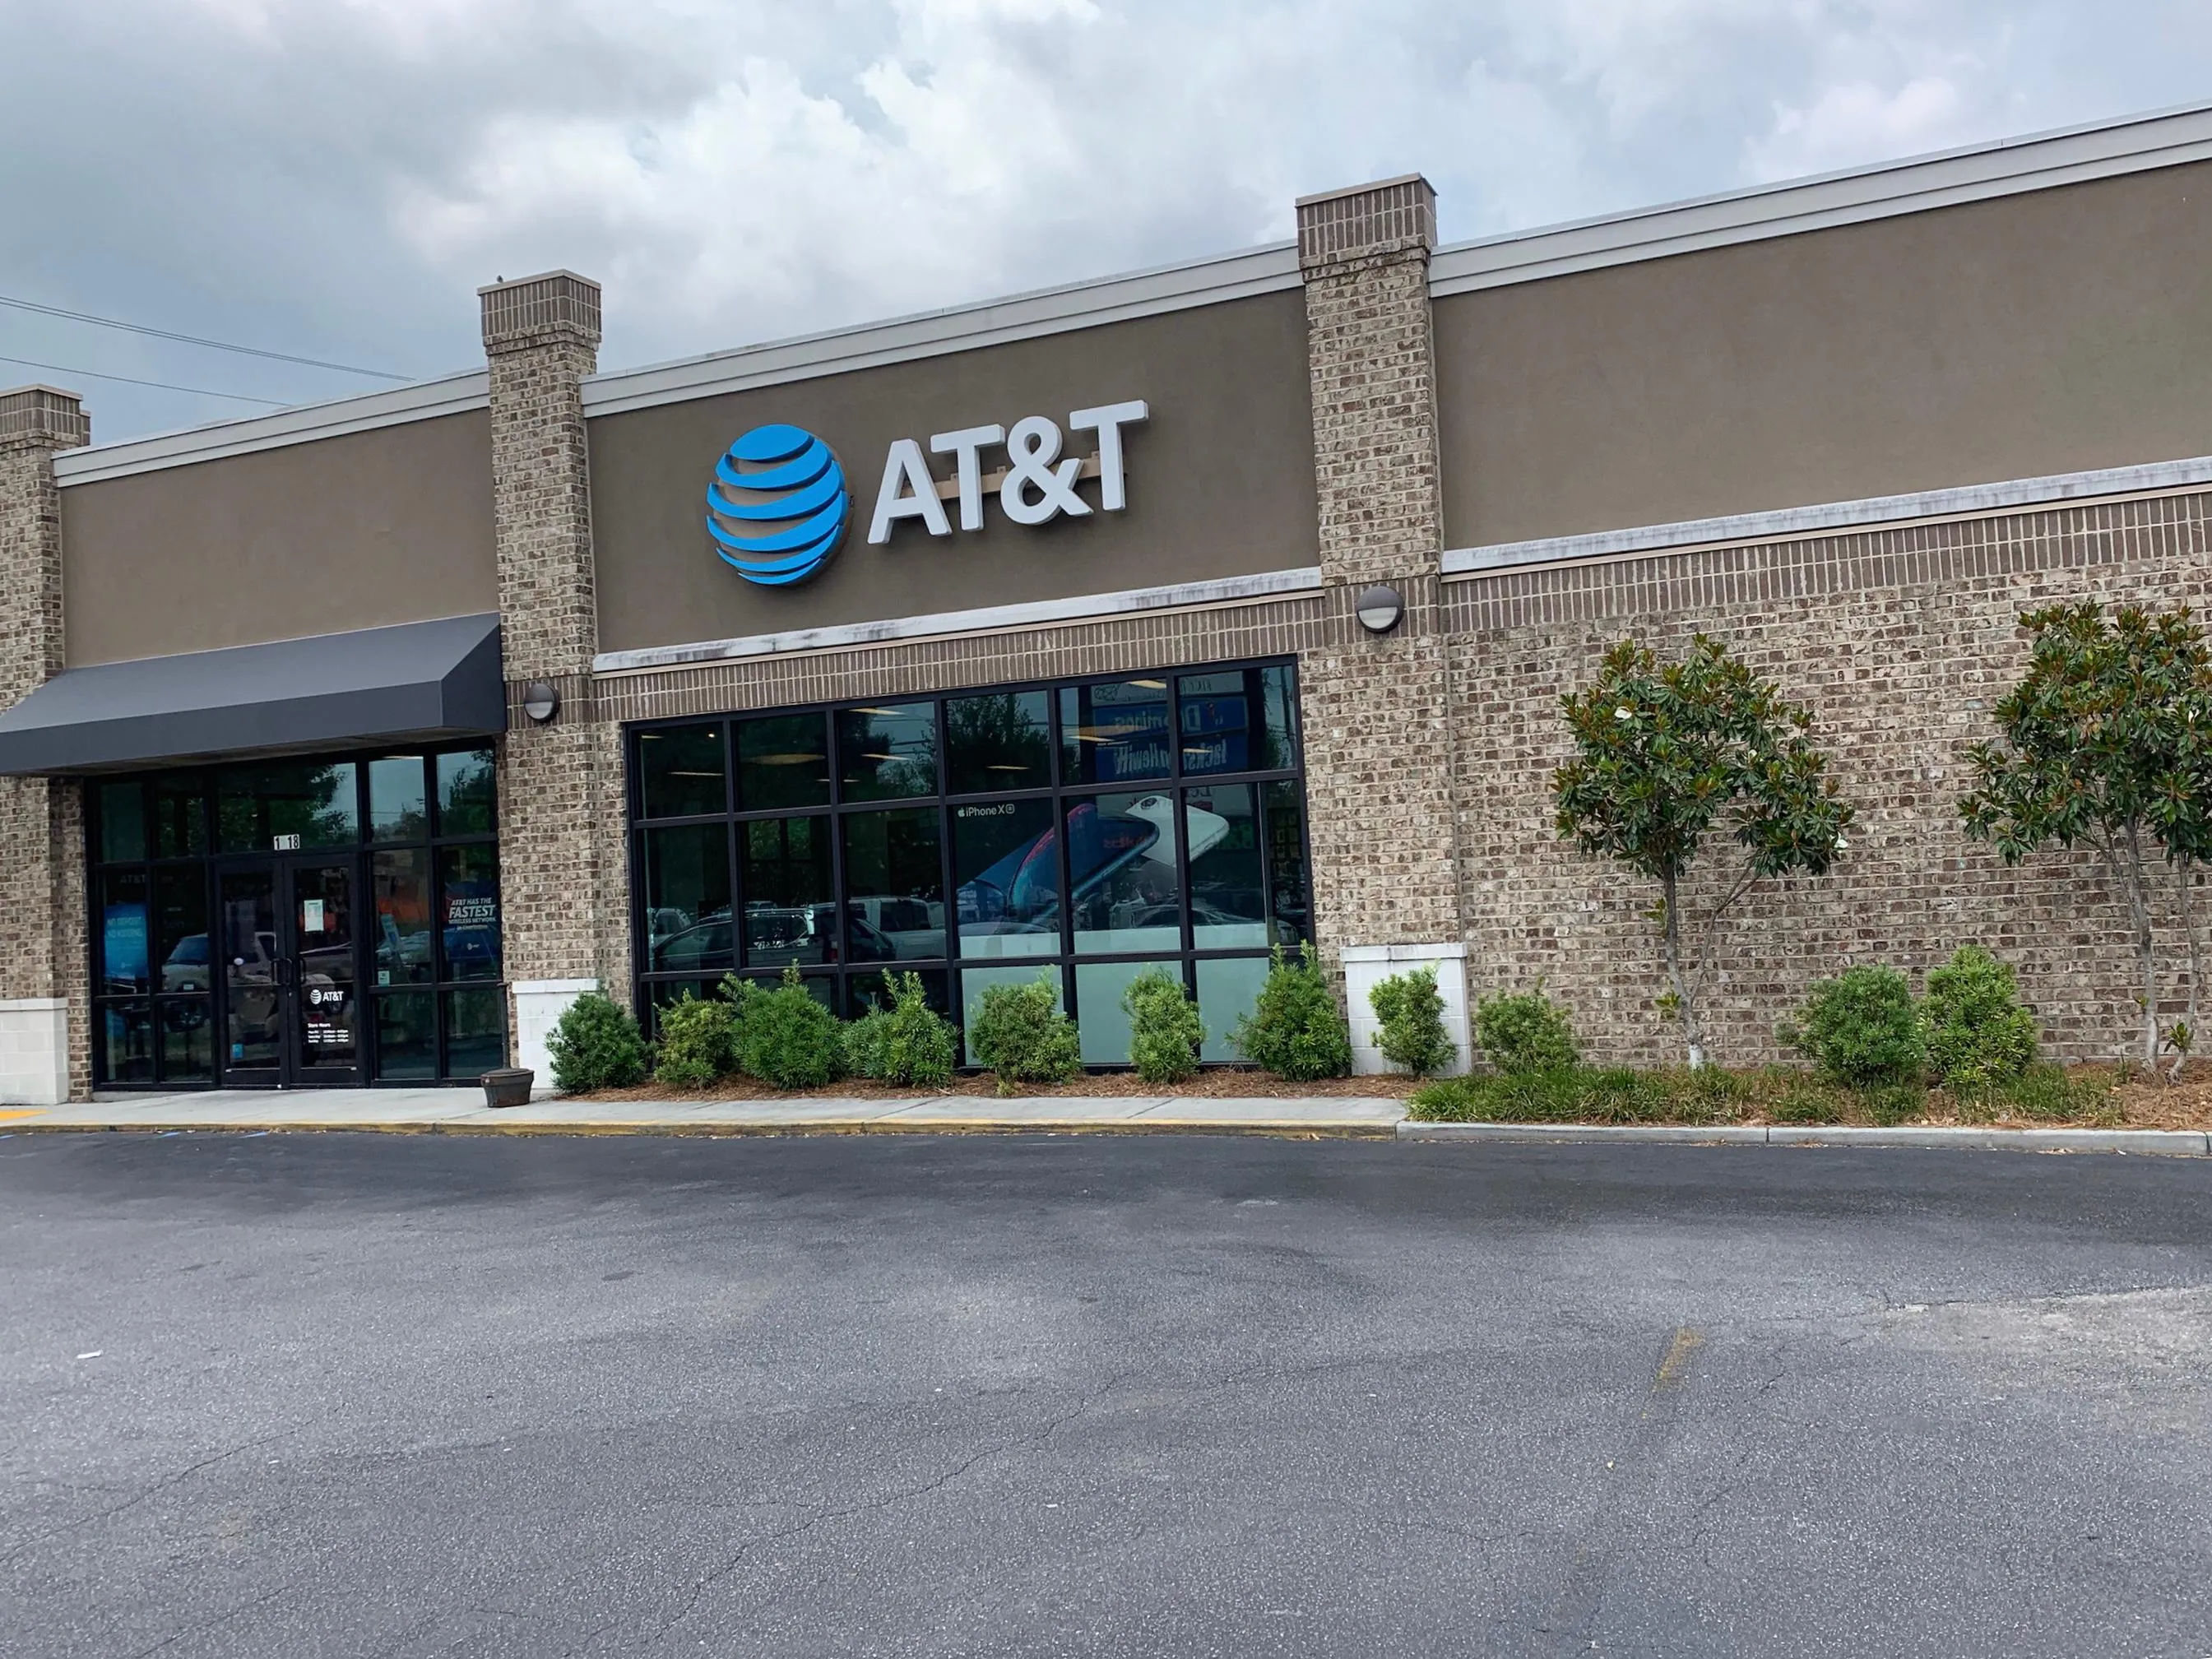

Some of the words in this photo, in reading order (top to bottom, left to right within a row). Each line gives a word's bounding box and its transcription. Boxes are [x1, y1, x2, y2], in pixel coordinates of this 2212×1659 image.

[867, 399, 1149, 545] AT&T
[966, 806, 997, 817] iPhone
[449, 905, 496, 918] FASTEST
[322, 991, 344, 1002] AT&T
